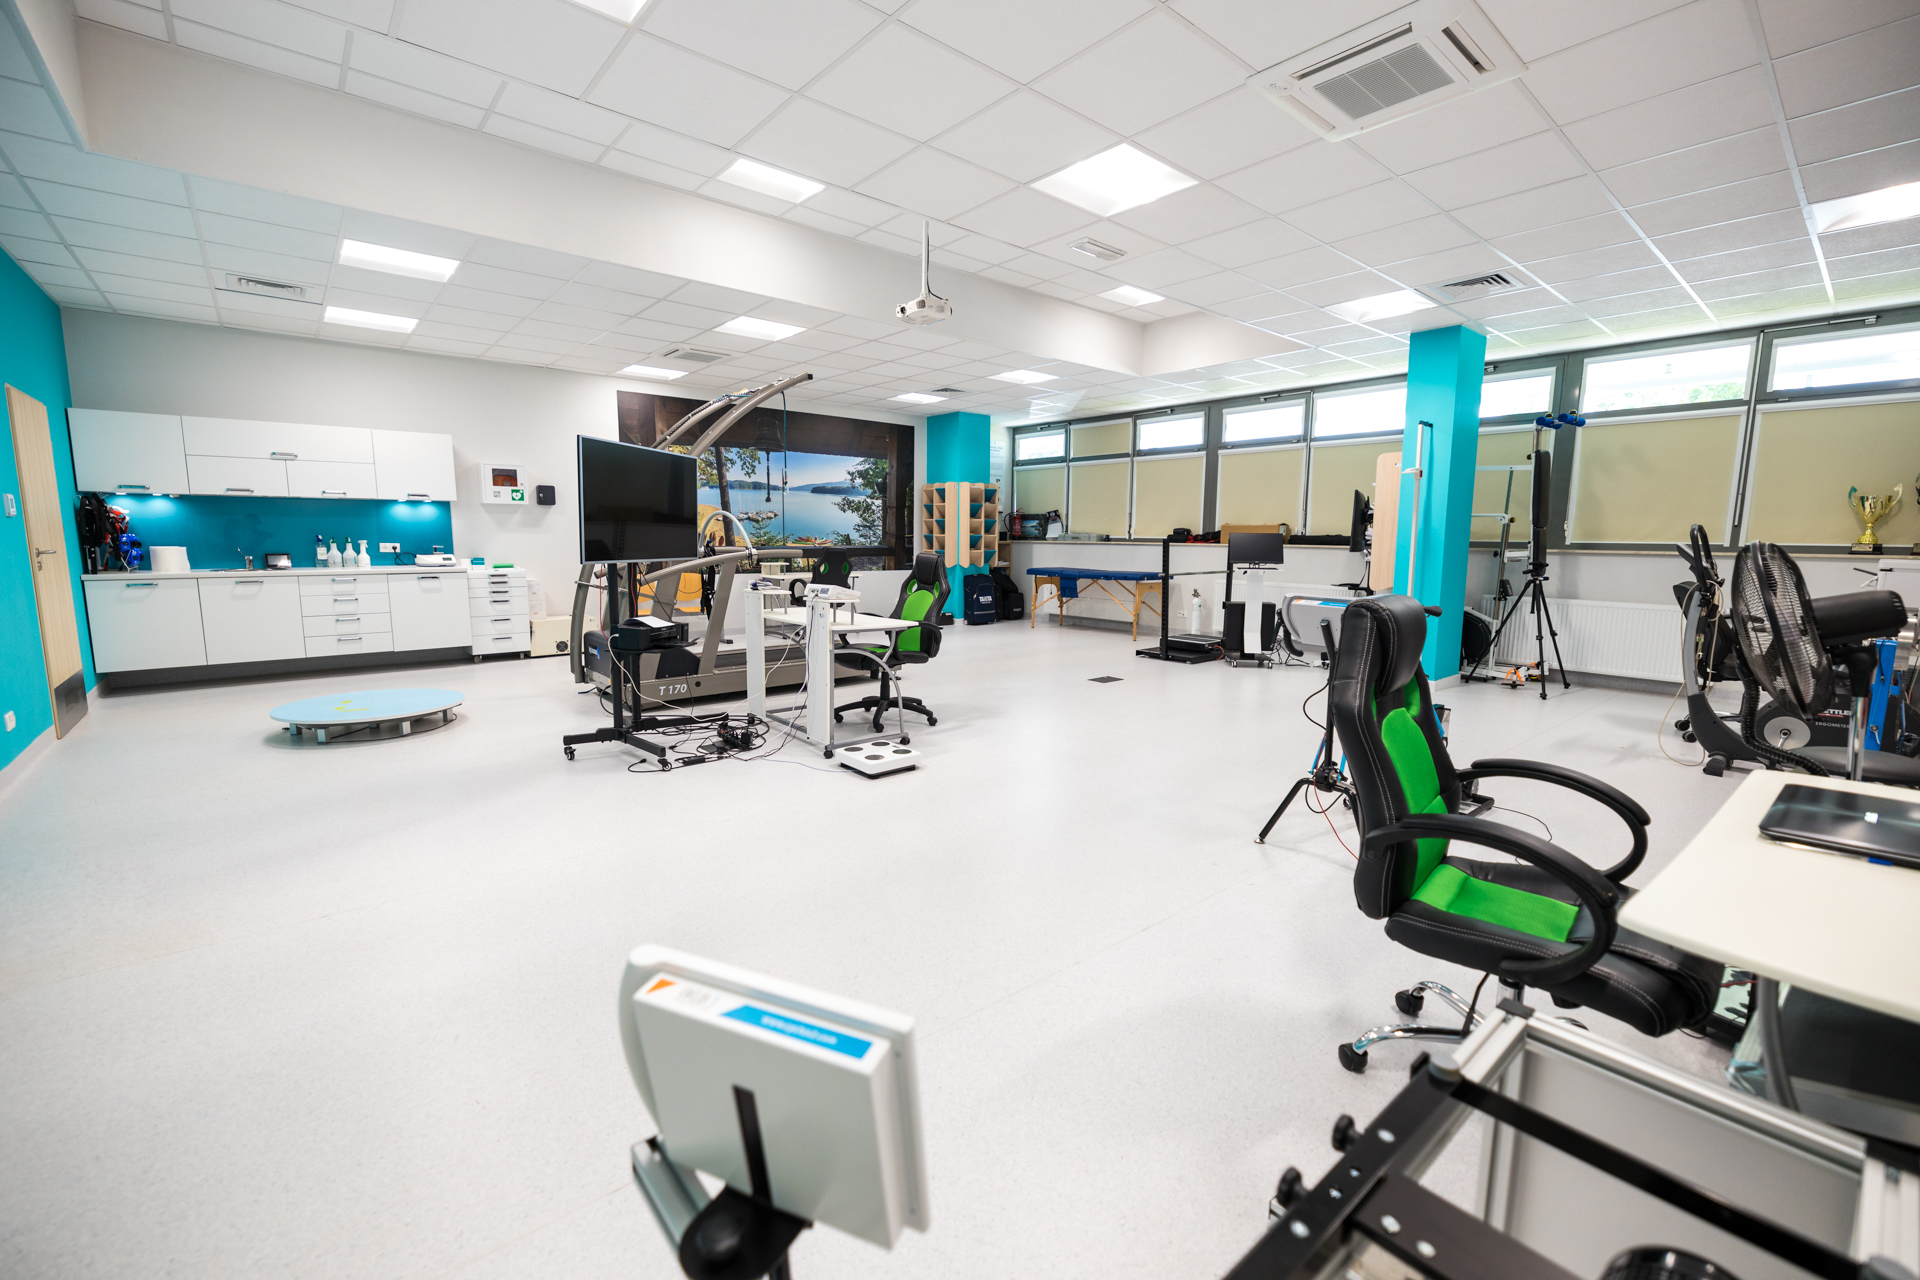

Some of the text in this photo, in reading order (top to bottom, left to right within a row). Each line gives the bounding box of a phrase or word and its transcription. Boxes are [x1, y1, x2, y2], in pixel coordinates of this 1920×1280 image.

[659, 684, 688, 696] T 170
[1822, 708, 1852, 716] TTLE
